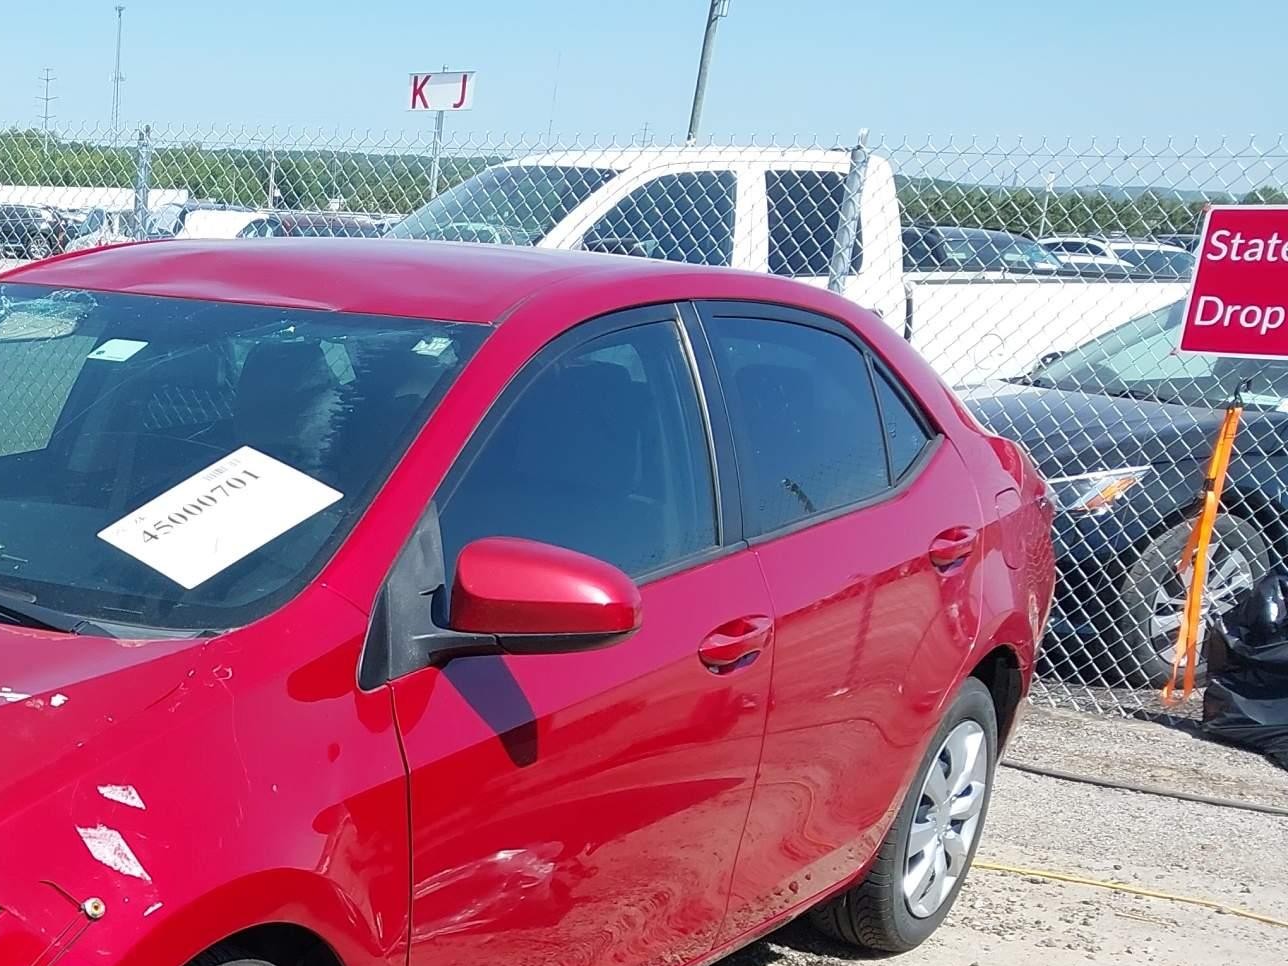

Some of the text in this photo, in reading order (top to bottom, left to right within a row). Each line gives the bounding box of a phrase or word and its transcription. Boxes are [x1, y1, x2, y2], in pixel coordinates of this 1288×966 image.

[411, 73, 468, 109] K J
[1194, 295, 1286, 335] Drop
[143, 470, 261, 543] 45000701
